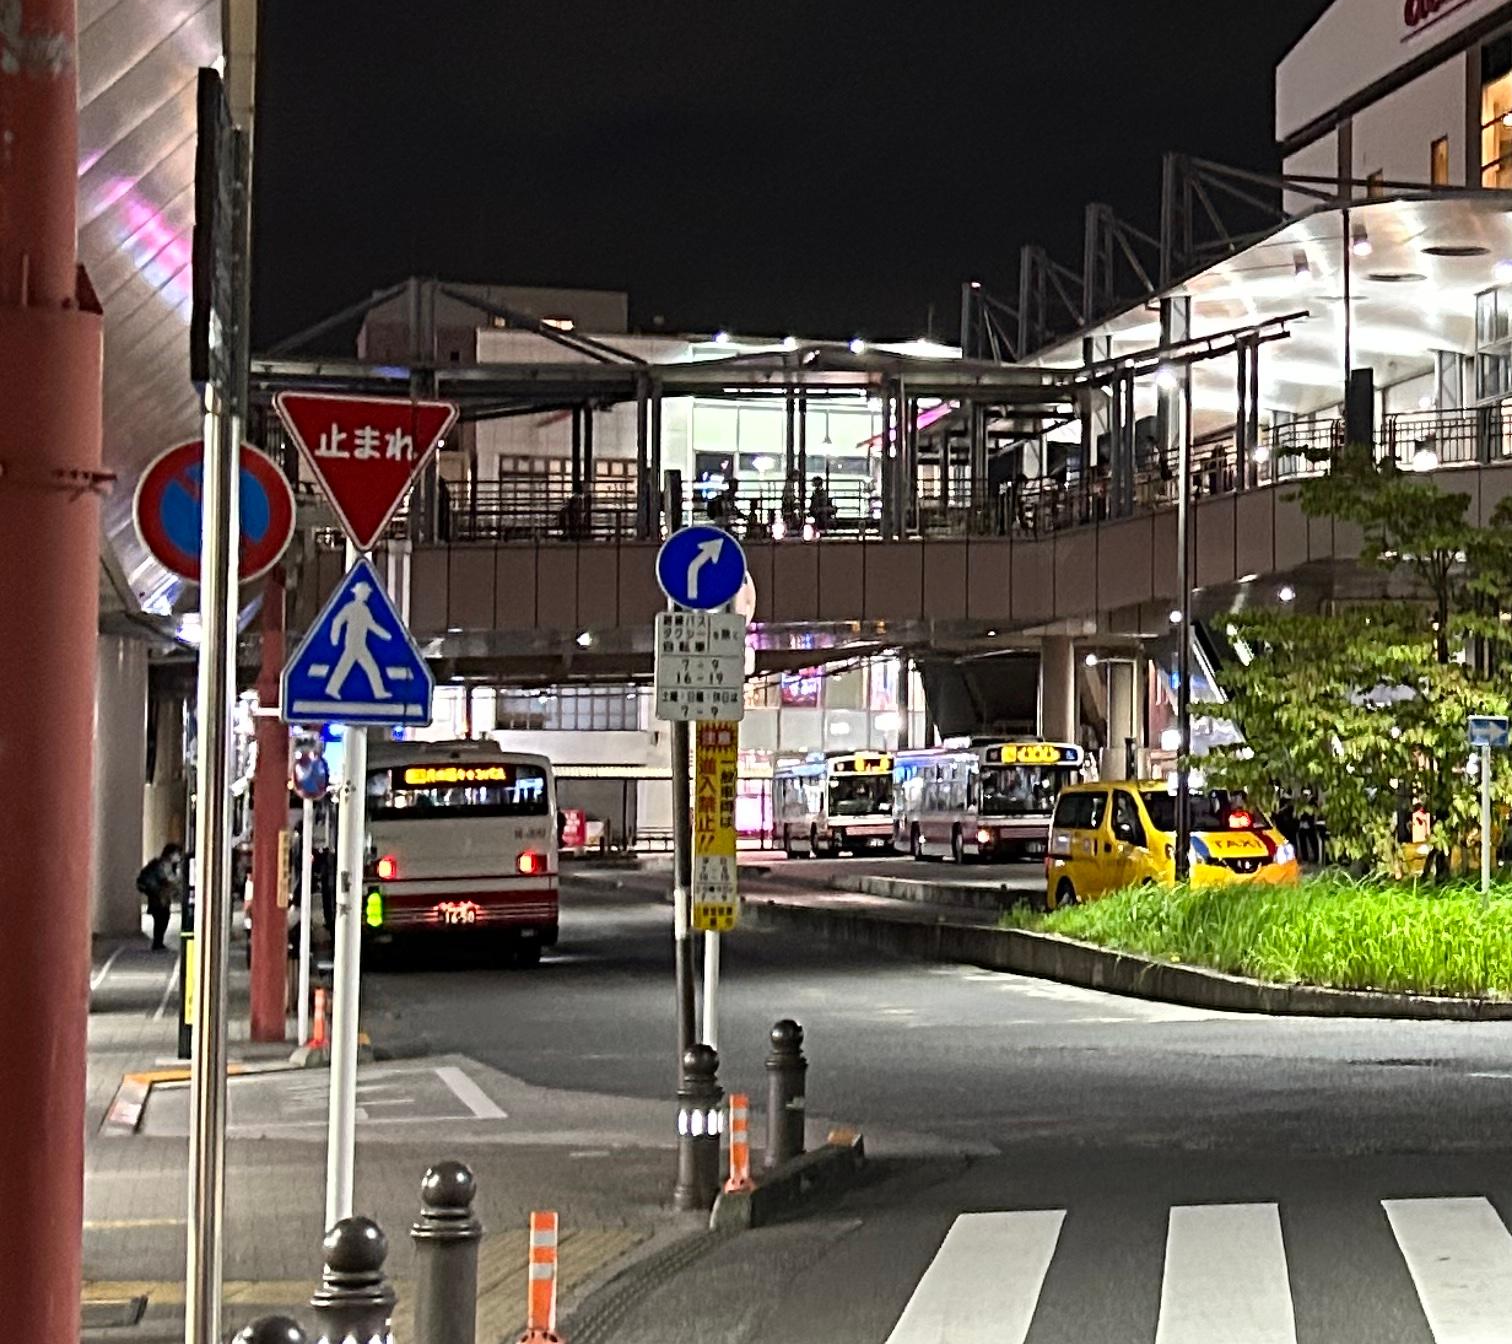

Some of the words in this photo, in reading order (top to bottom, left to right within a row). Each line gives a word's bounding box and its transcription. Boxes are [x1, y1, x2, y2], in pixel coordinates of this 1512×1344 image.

[314, 422, 418, 461] 止まれ
[1214, 839, 1263, 849] TAXI
